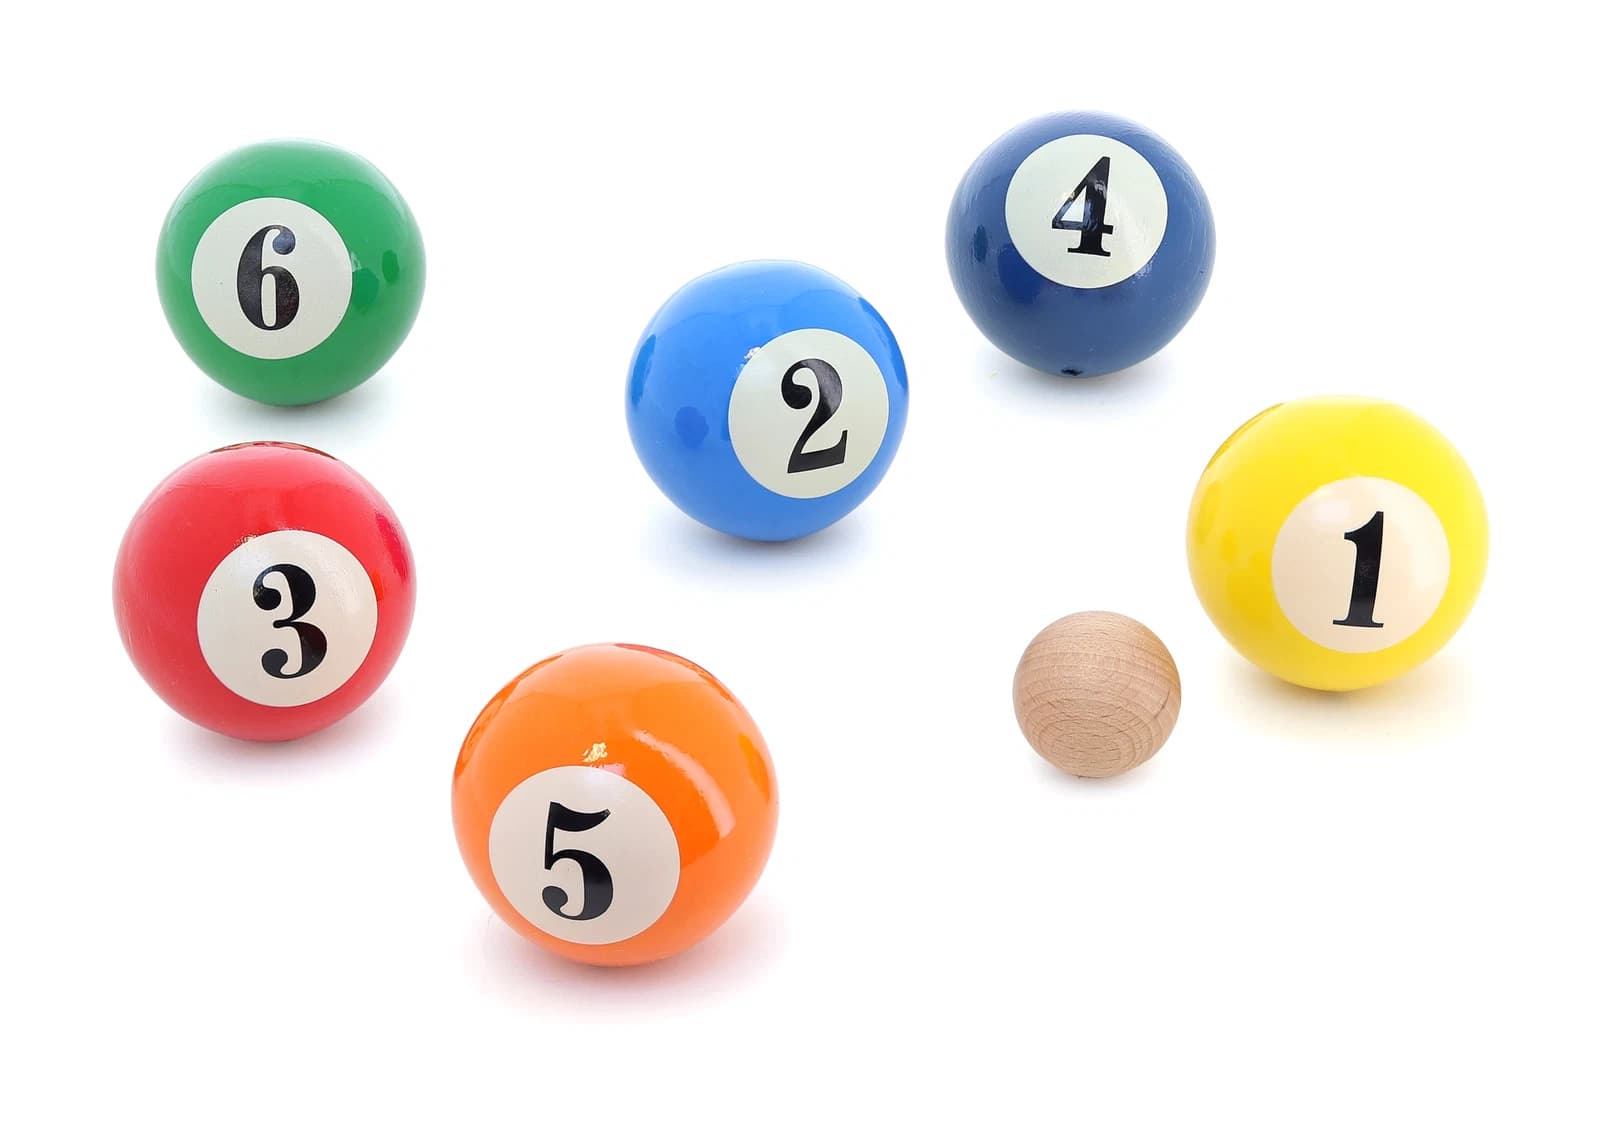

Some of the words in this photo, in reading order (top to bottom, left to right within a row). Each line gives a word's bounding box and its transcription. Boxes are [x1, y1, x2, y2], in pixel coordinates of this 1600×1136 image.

[1051, 155, 1114, 256] 4
[237, 225, 299, 330] 6
[780, 359, 847, 473] 2
[253, 564, 328, 679] 3
[1333, 510, 1385, 627] 1
[541, 801, 614, 920] 5
